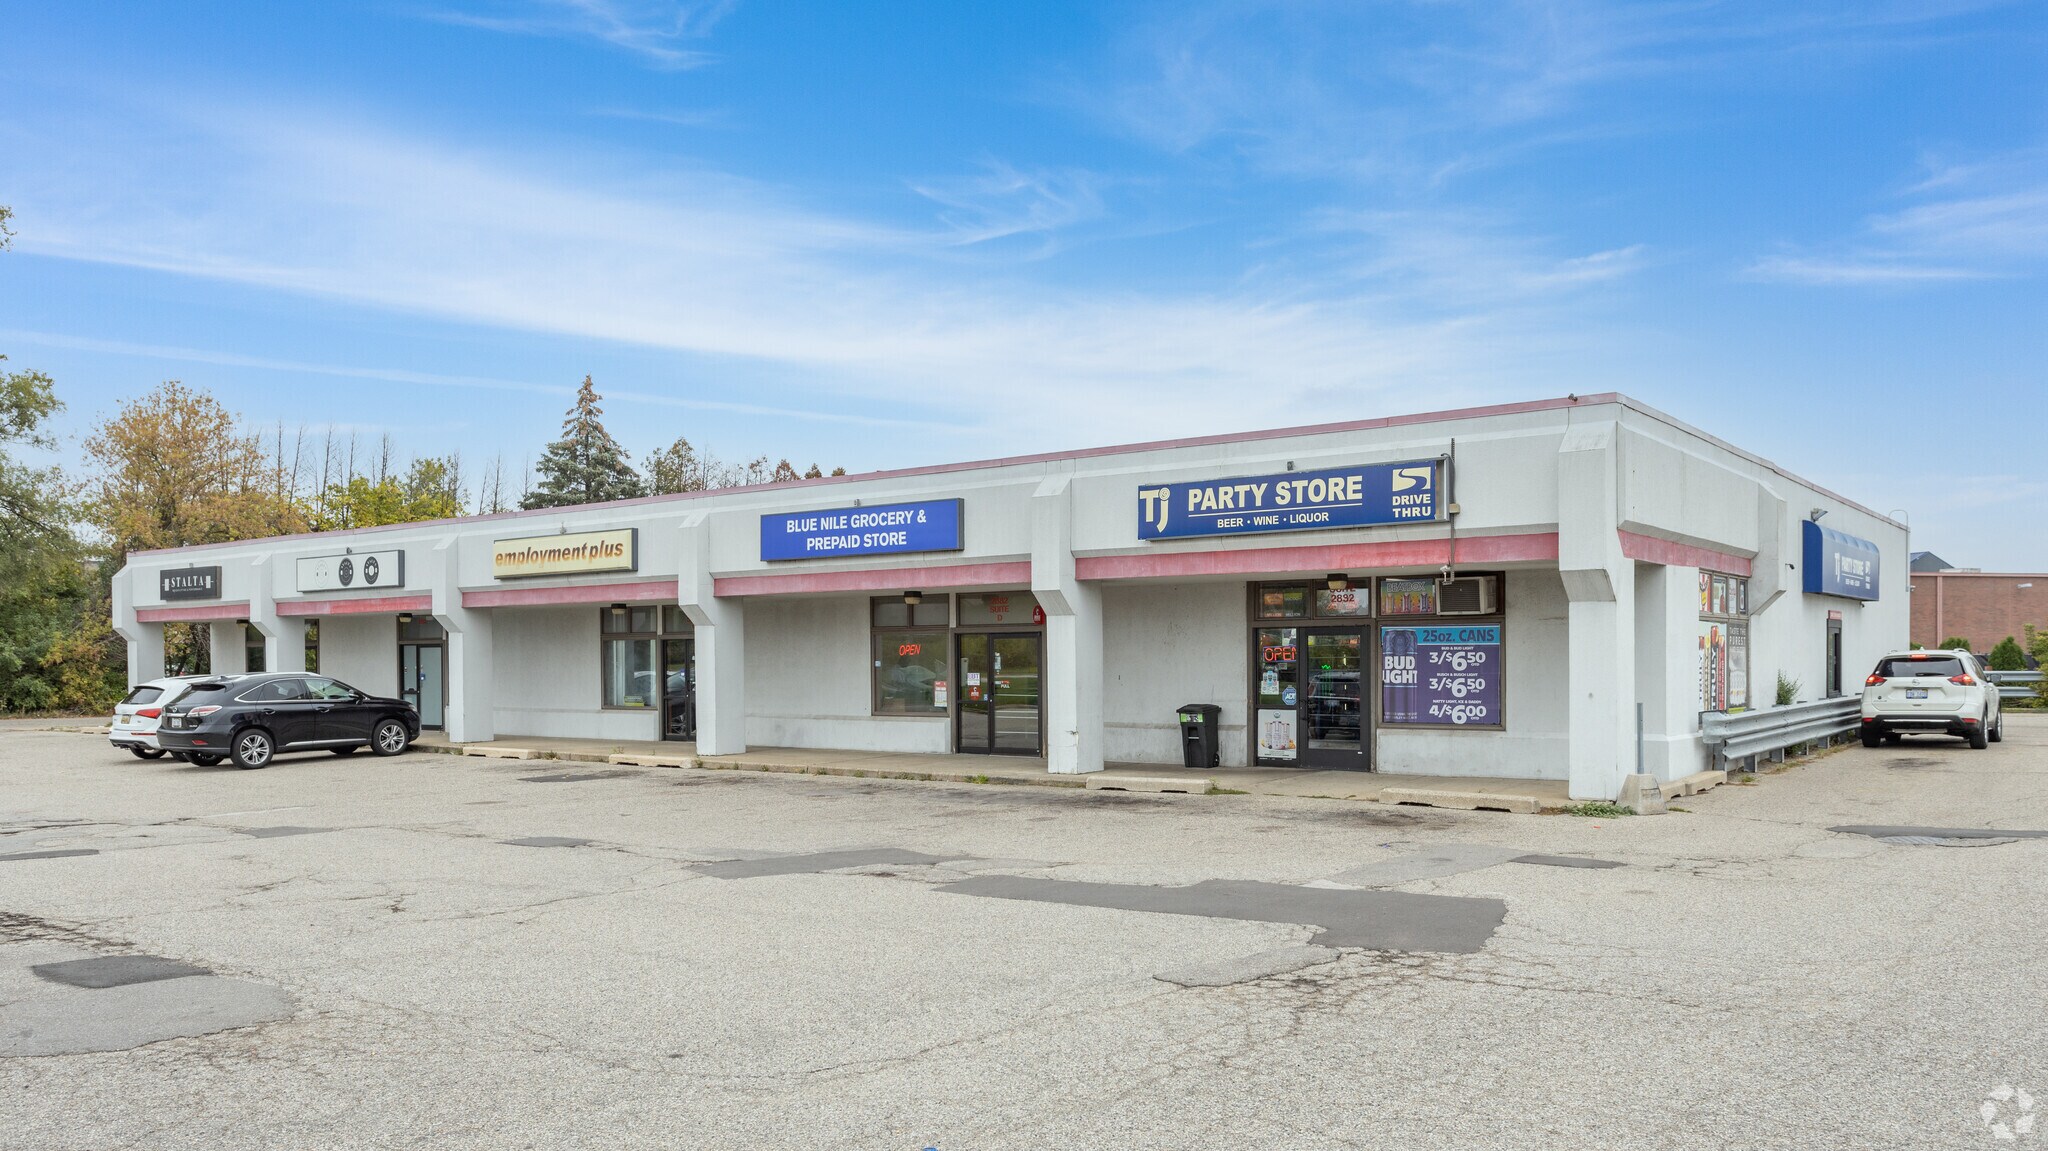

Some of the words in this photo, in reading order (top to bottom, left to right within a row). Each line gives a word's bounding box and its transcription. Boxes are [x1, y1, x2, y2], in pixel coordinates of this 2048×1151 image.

[1188, 483, 1268, 511] PARTY
[1275, 475, 1363, 506] STORE
[1392, 493, 1431, 506] DRIVE
[1392, 506, 1431, 518] THRU
[786, 518, 817, 533] BLUE
[820, 515, 848, 530] NILE
[850, 510, 914, 529] GROCERY
[917, 509, 927, 523] &
[1217, 518, 1243, 528] BEER
[1253, 515, 1279, 526] WINE
[1290, 512, 1329, 524] LIQUOR
[806, 534, 861, 551] PREPAID
[863, 531, 907, 548] STORE
[495, 543, 588, 568] employment
[588, 540, 624, 564] plus
[171, 575, 204, 588] STALTA
[1330, 594, 1355, 603] 2892
[1422, 629, 1456, 642] 25oz.
[1459, 629, 1495, 642] CANS
[899, 644, 921, 656] OPEN
[1384, 655, 1416, 670] BUD
